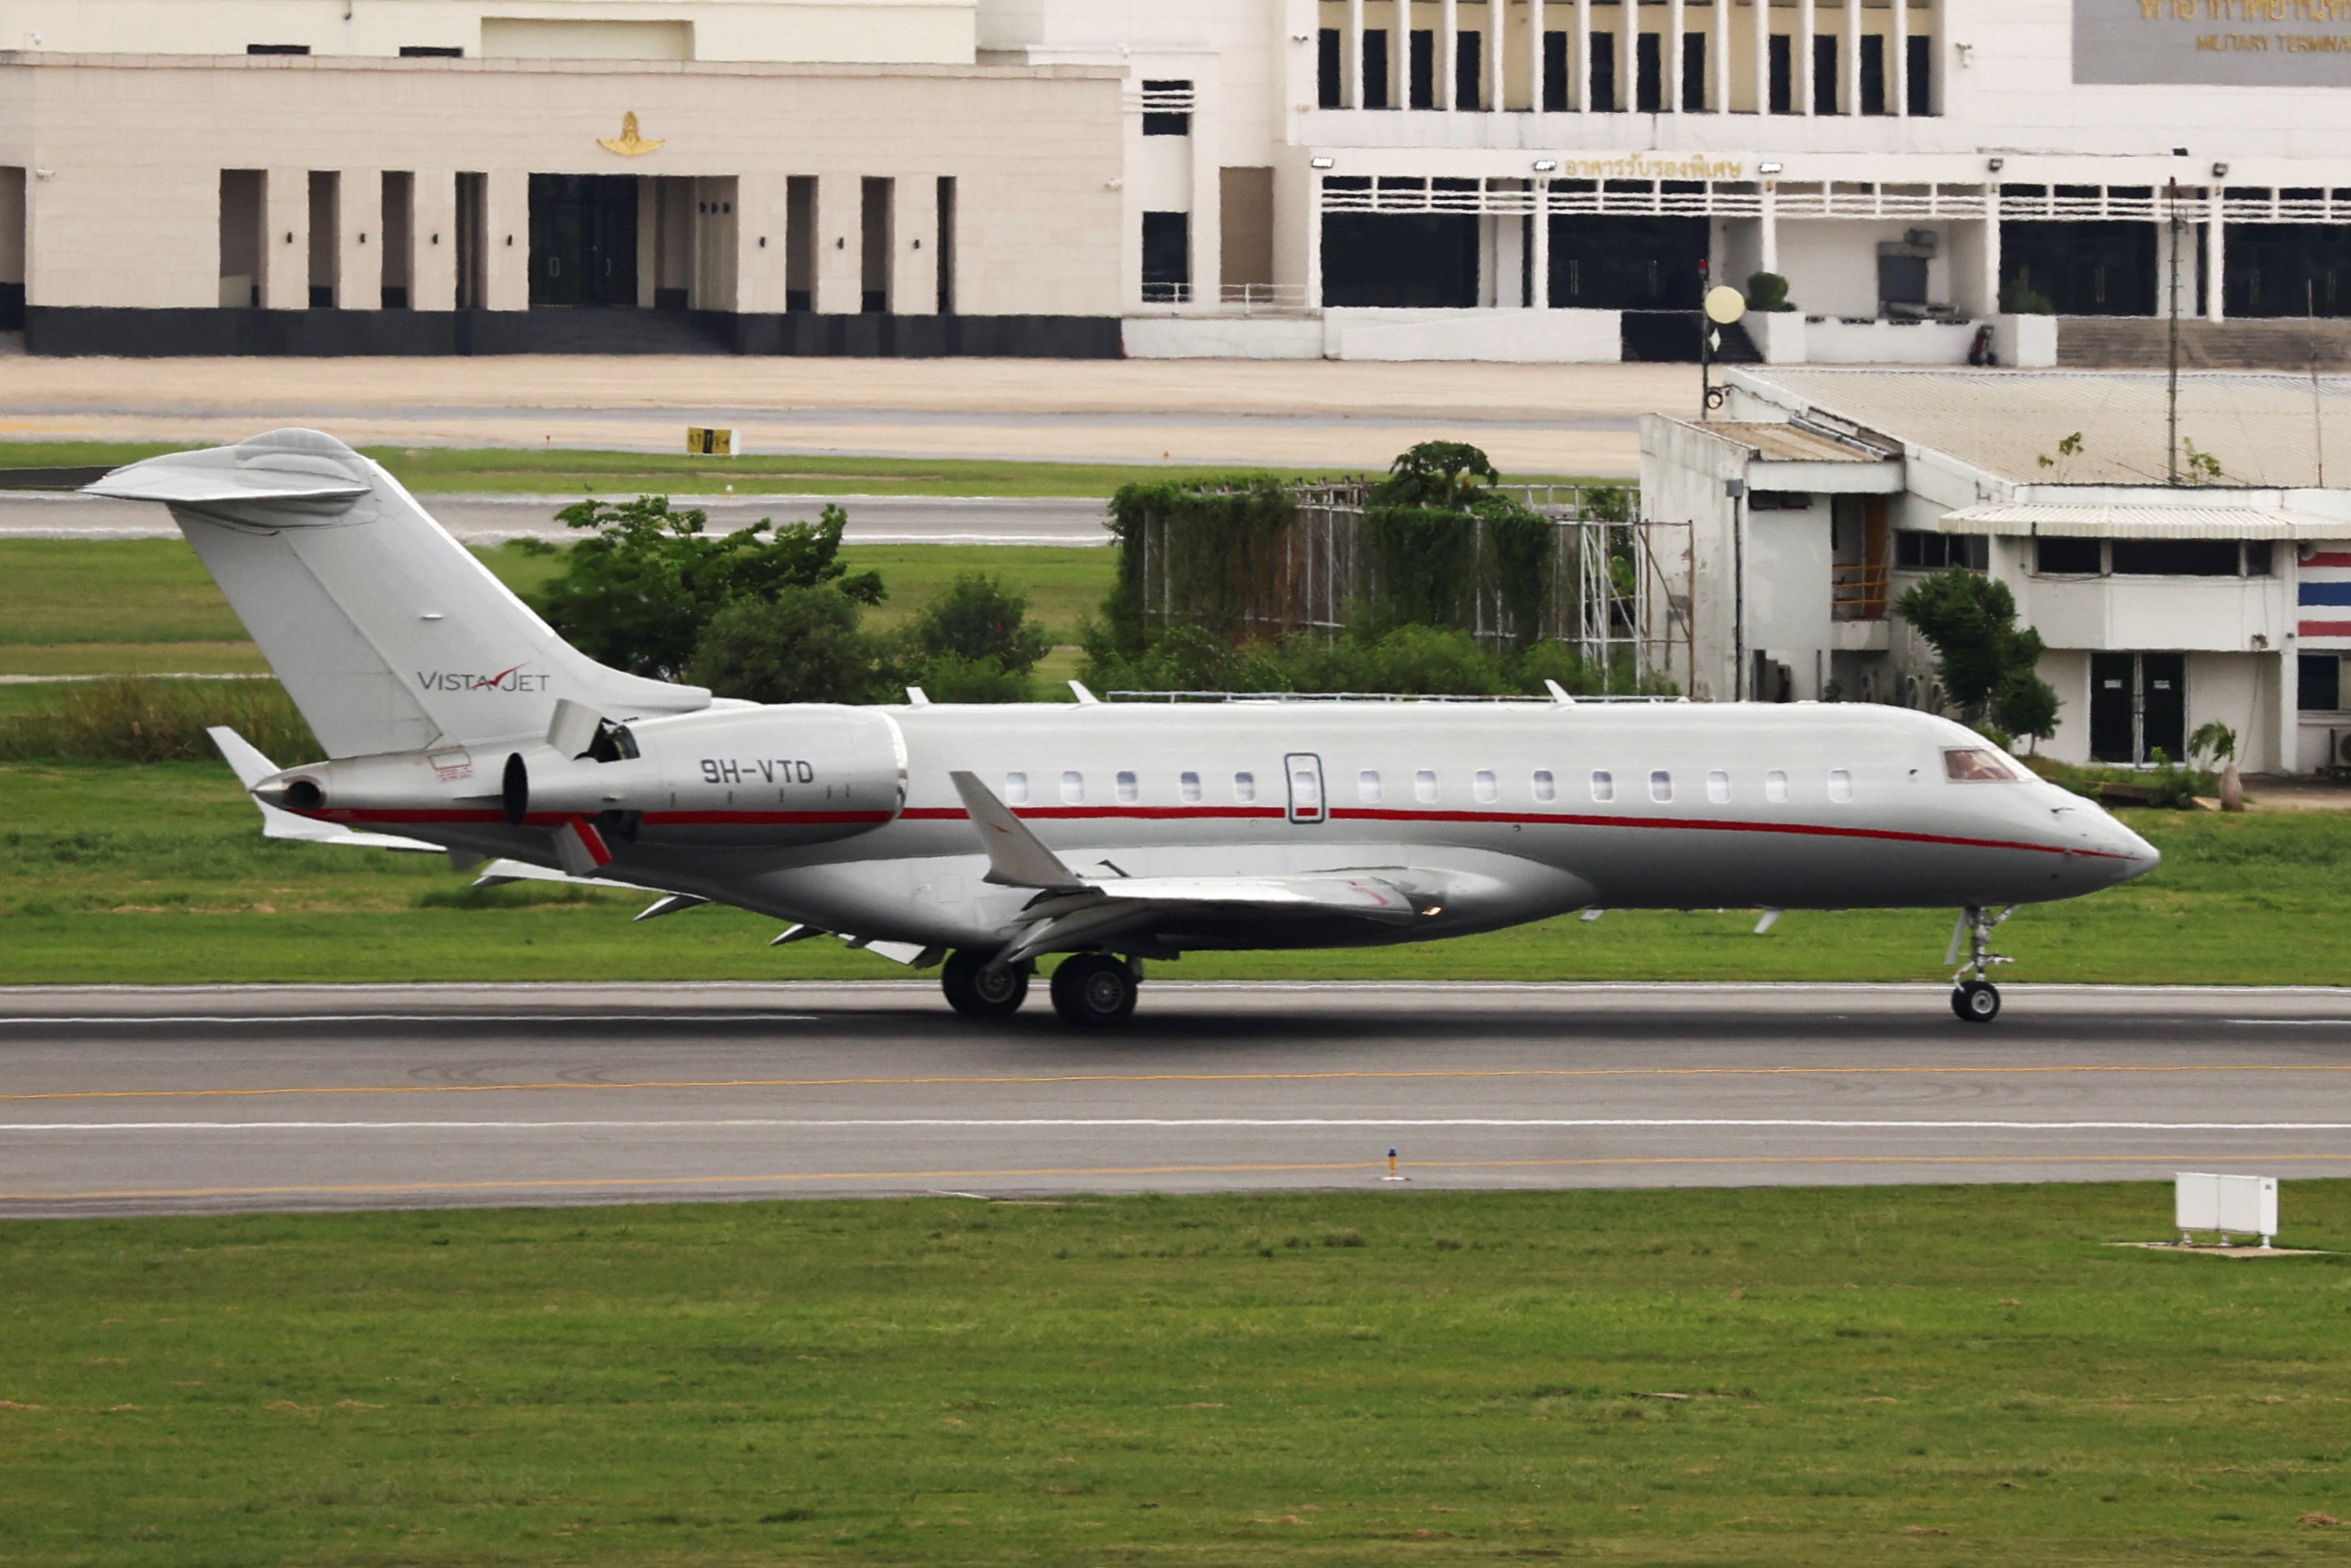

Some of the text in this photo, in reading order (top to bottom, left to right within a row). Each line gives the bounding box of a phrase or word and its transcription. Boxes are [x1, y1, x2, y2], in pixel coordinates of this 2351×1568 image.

[2196, 34, 2271, 51] MILITARY
[1565, 151, 1743, 176] อาคารรับรองพิเศษ
[700, 758, 814, 784] 9H-VTD
